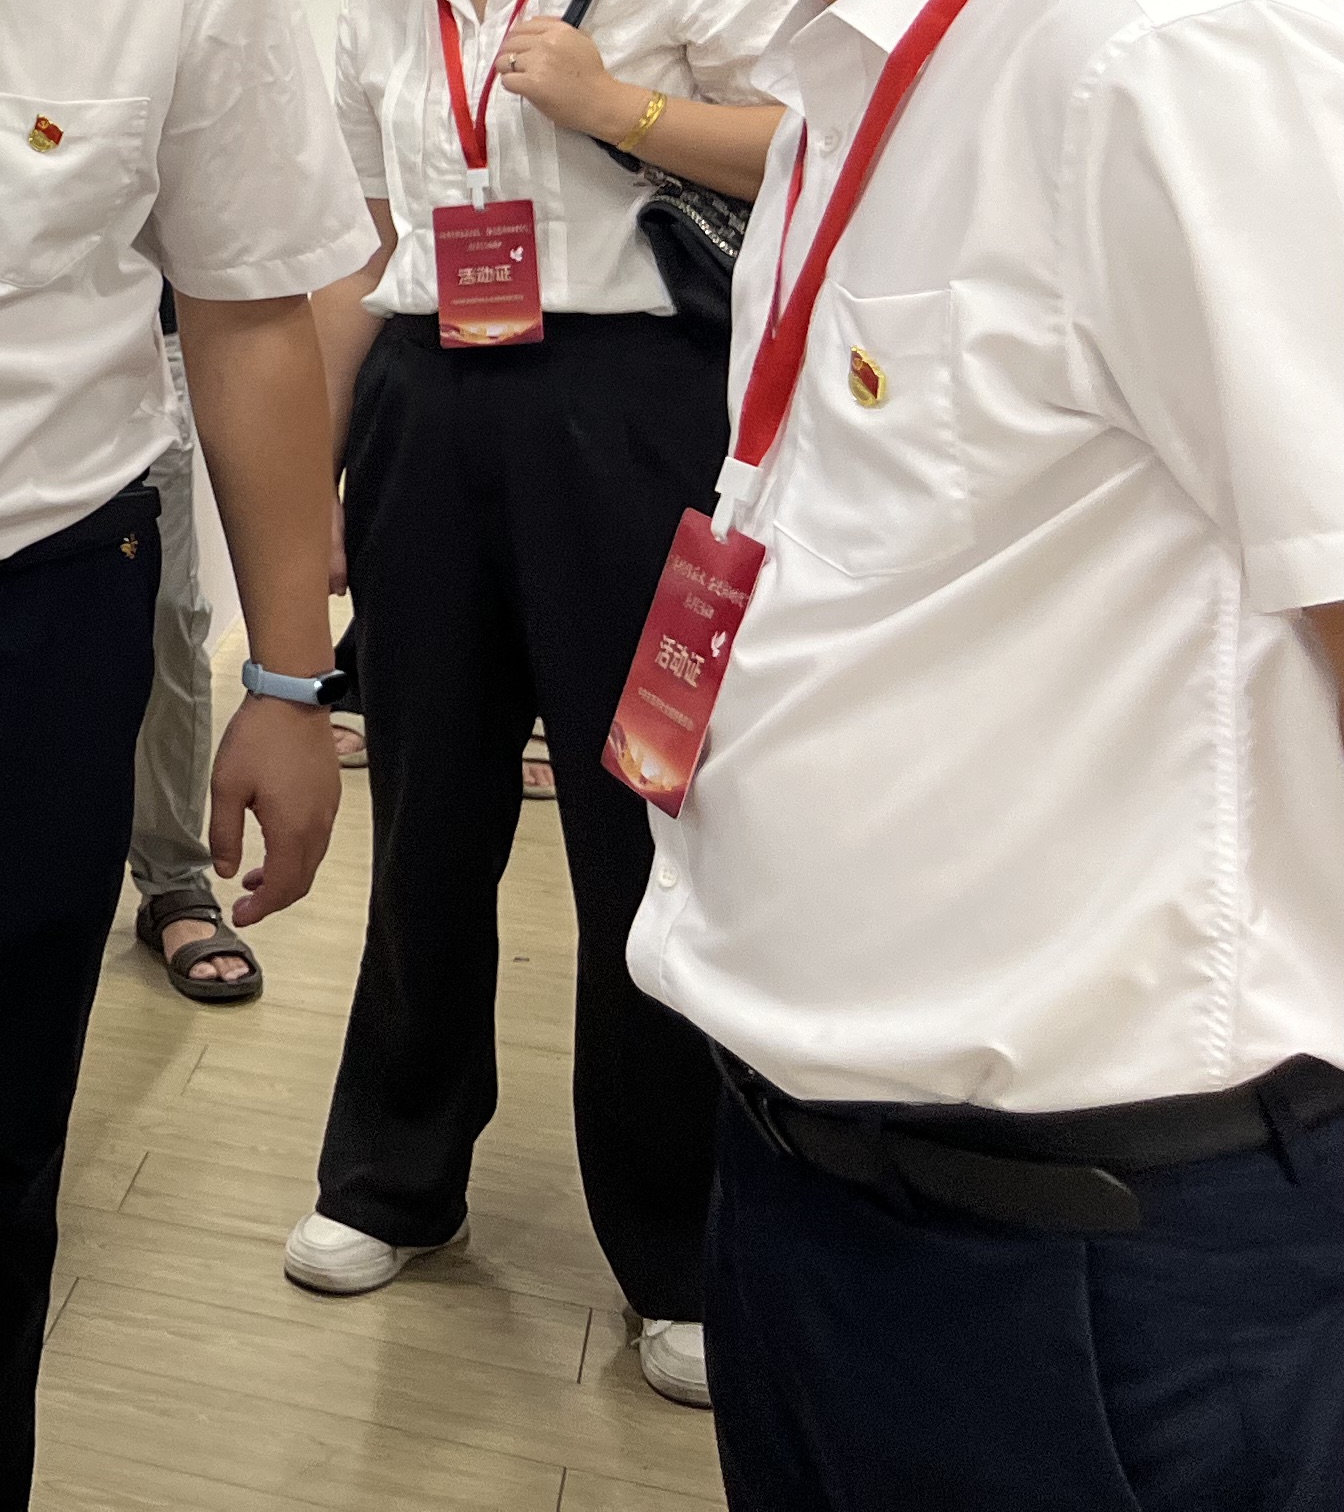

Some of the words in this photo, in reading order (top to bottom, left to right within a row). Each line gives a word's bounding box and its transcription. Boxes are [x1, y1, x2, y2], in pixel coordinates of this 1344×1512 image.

[457, 263, 513, 286] 活动证
[654, 634, 706, 688] 活动证
